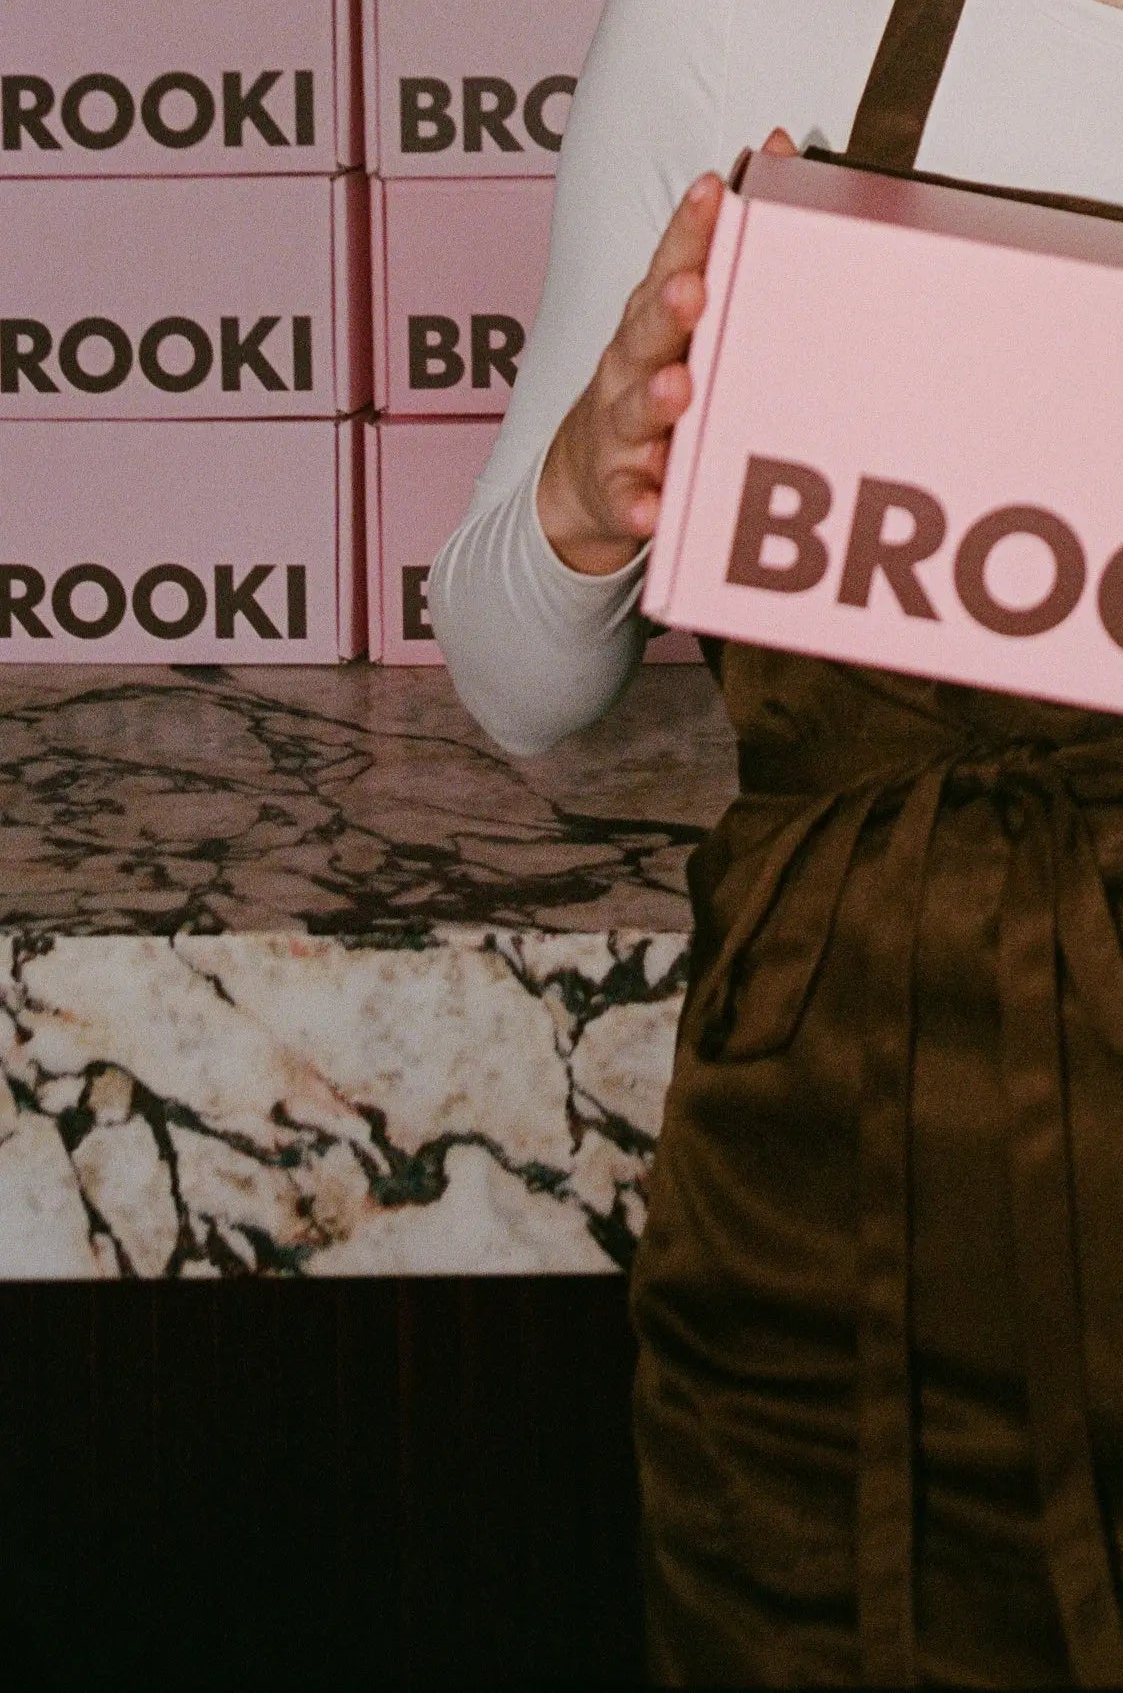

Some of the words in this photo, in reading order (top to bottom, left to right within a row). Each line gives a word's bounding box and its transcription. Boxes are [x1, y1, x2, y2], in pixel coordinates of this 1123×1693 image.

[0, 71, 314, 150] ROOKI
[400, 76, 577, 153] BRO
[0, 317, 312, 393] ROOKI
[0, 564, 306, 639] ROOKI
